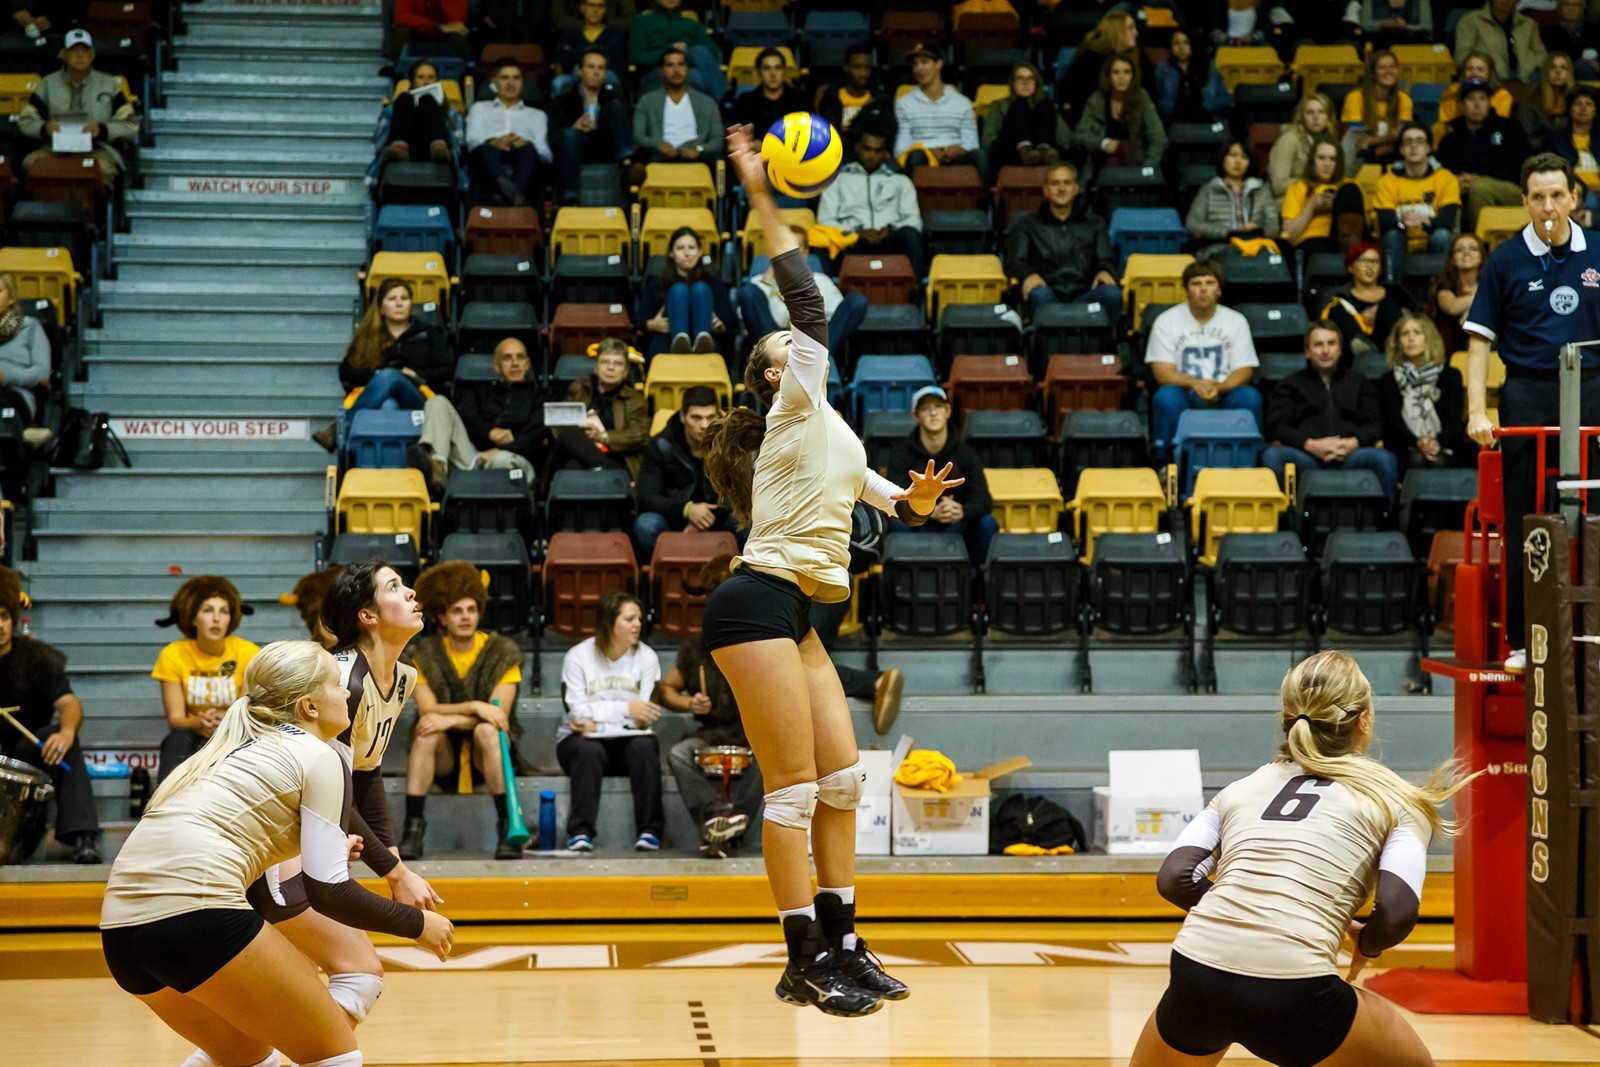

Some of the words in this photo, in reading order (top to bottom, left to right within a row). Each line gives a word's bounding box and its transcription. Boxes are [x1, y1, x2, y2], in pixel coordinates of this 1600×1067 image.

[188, 179, 241, 193] WATCH
[245, 180, 288, 194] YOUR
[292, 181, 331, 195] STEP
[1182, 345, 1222, 379] 67
[124, 420, 185, 435] WATCH
[192, 421, 239, 435] YOUR
[245, 421, 289, 436] STEP
[114, 753, 158, 769] YOU
[1531, 623, 1549, 884] BISONS
[1260, 774, 1335, 822] 6
